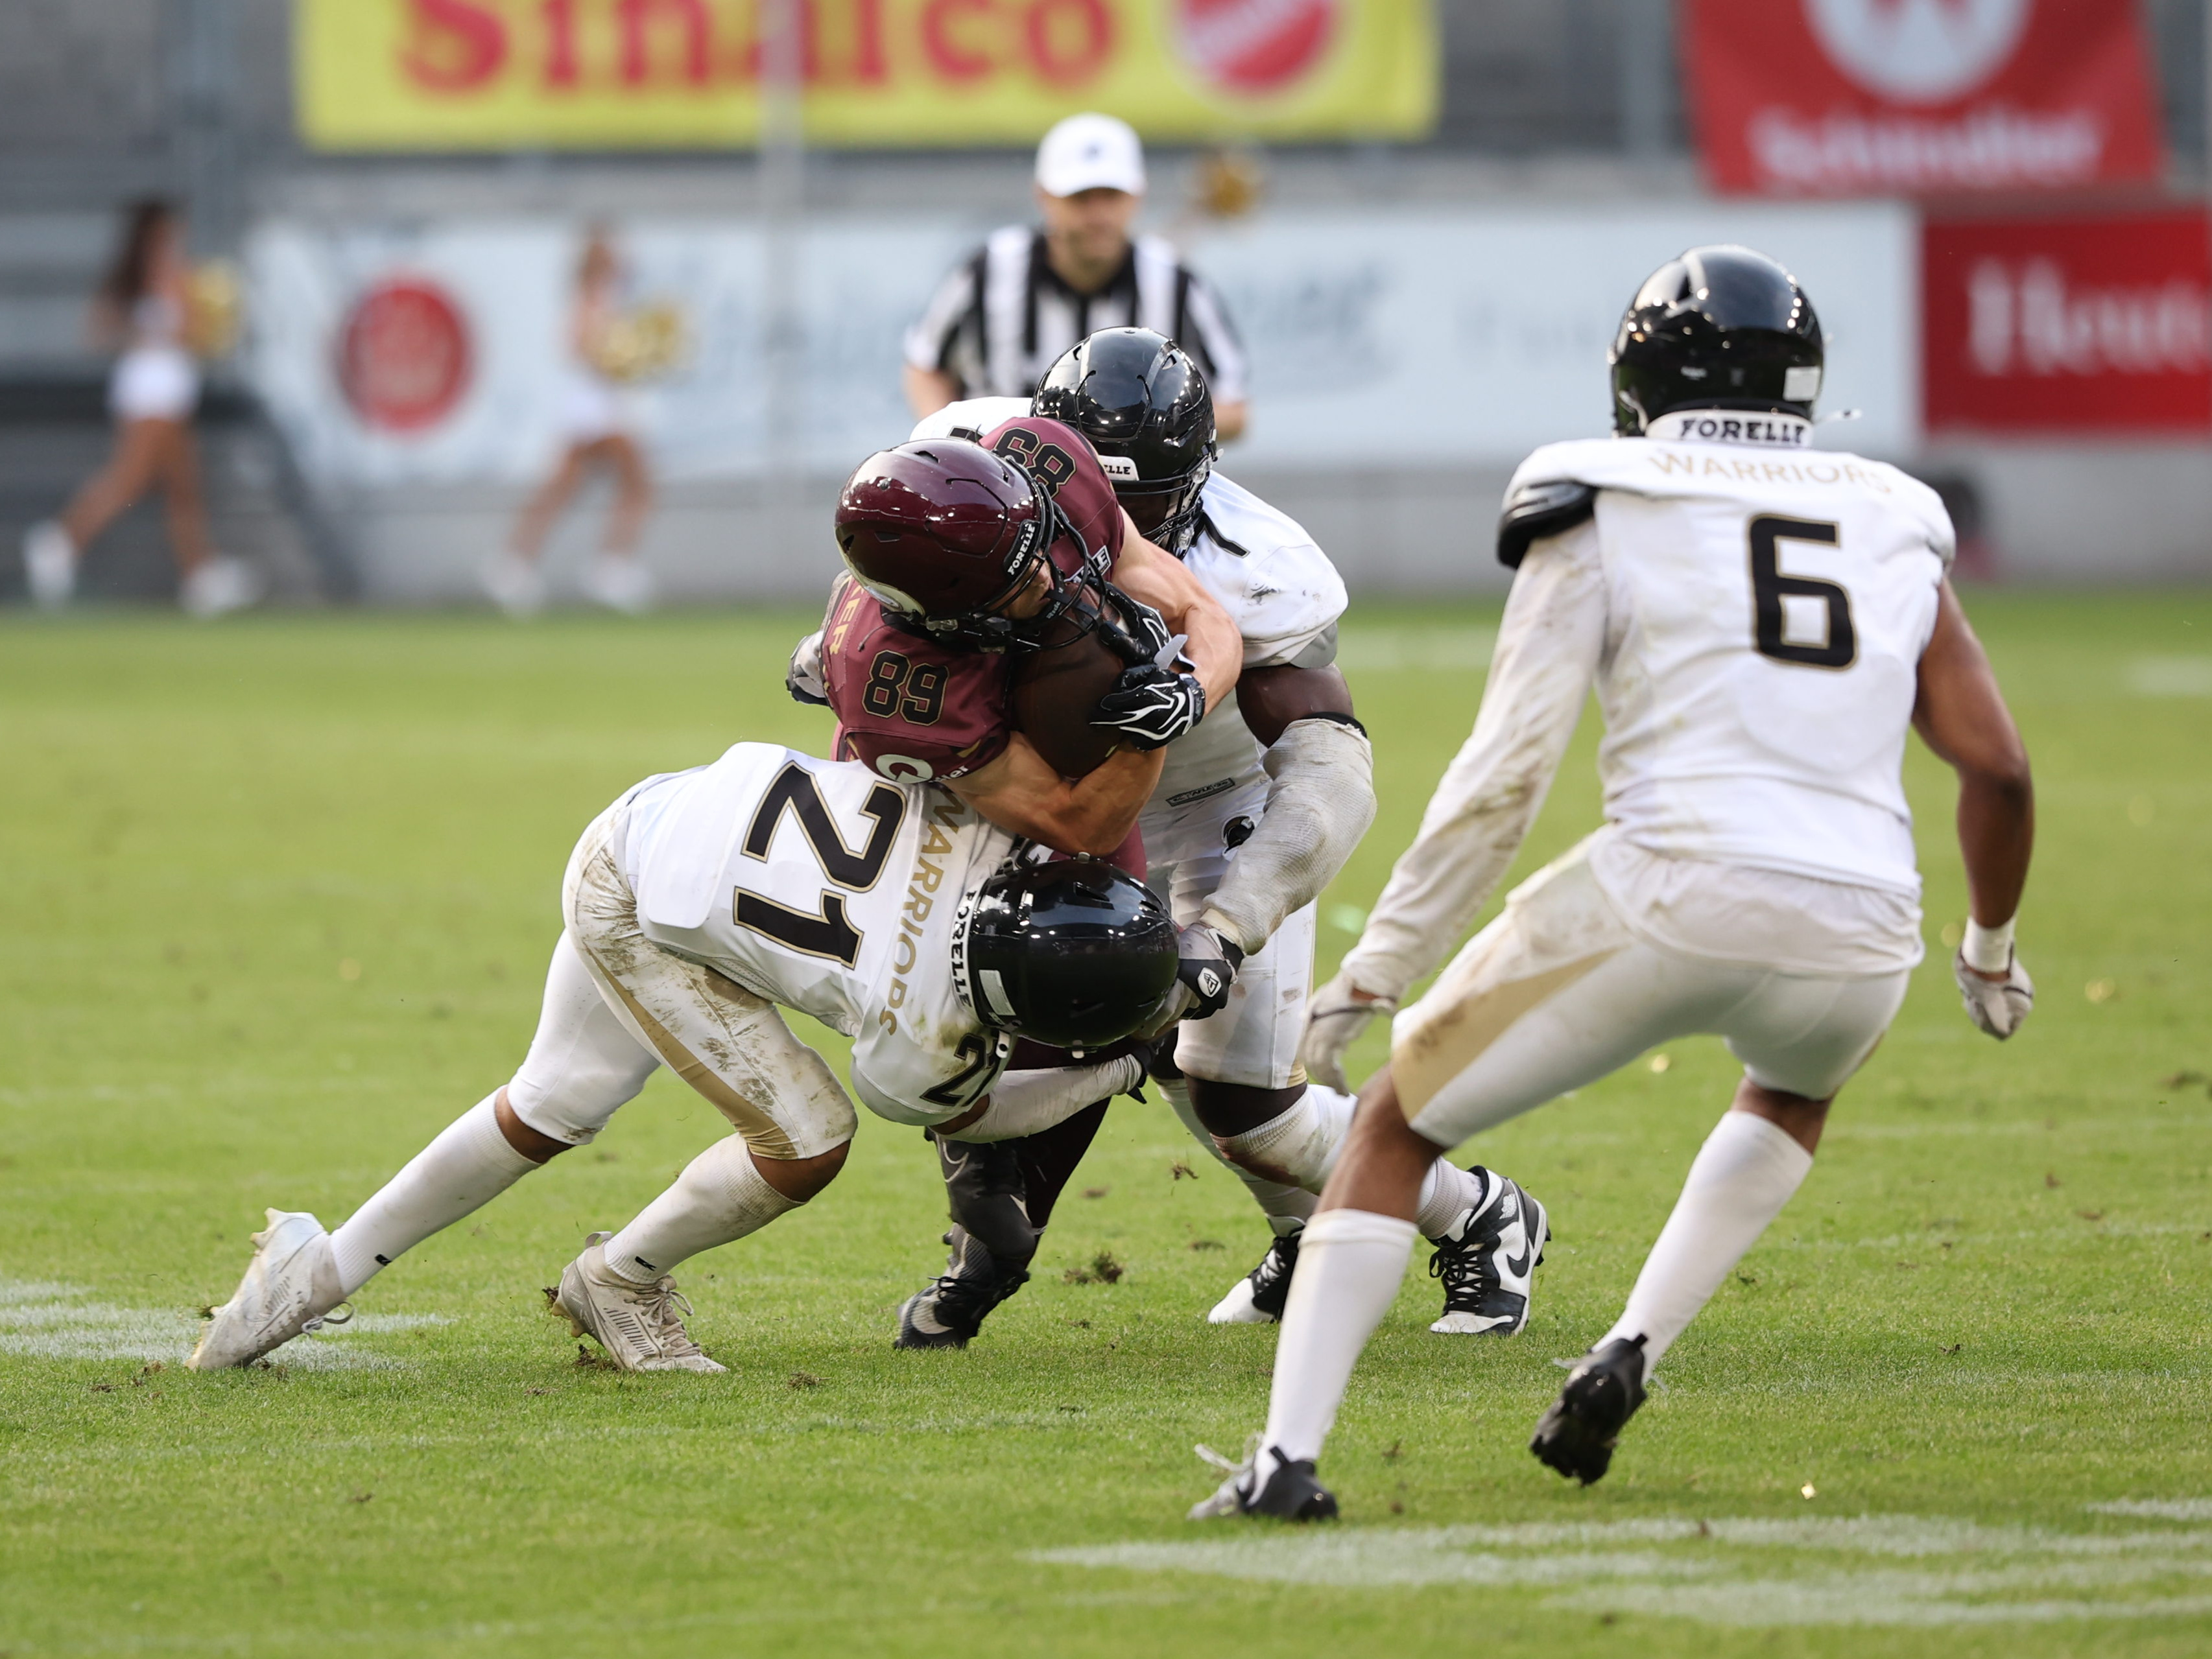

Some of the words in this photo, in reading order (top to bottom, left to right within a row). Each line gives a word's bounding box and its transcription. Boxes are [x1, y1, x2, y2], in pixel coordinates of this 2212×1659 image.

[1648, 453, 1892, 495] WARRIORS
[1006, 523, 1036, 576] FORELLE
[1748, 512, 1858, 672] 6
[861, 649, 950, 726] 89
[733, 760, 908, 971] 21
[879, 783, 965, 1036] WARRIORS
[951, 889, 977, 1007] FORELLE
